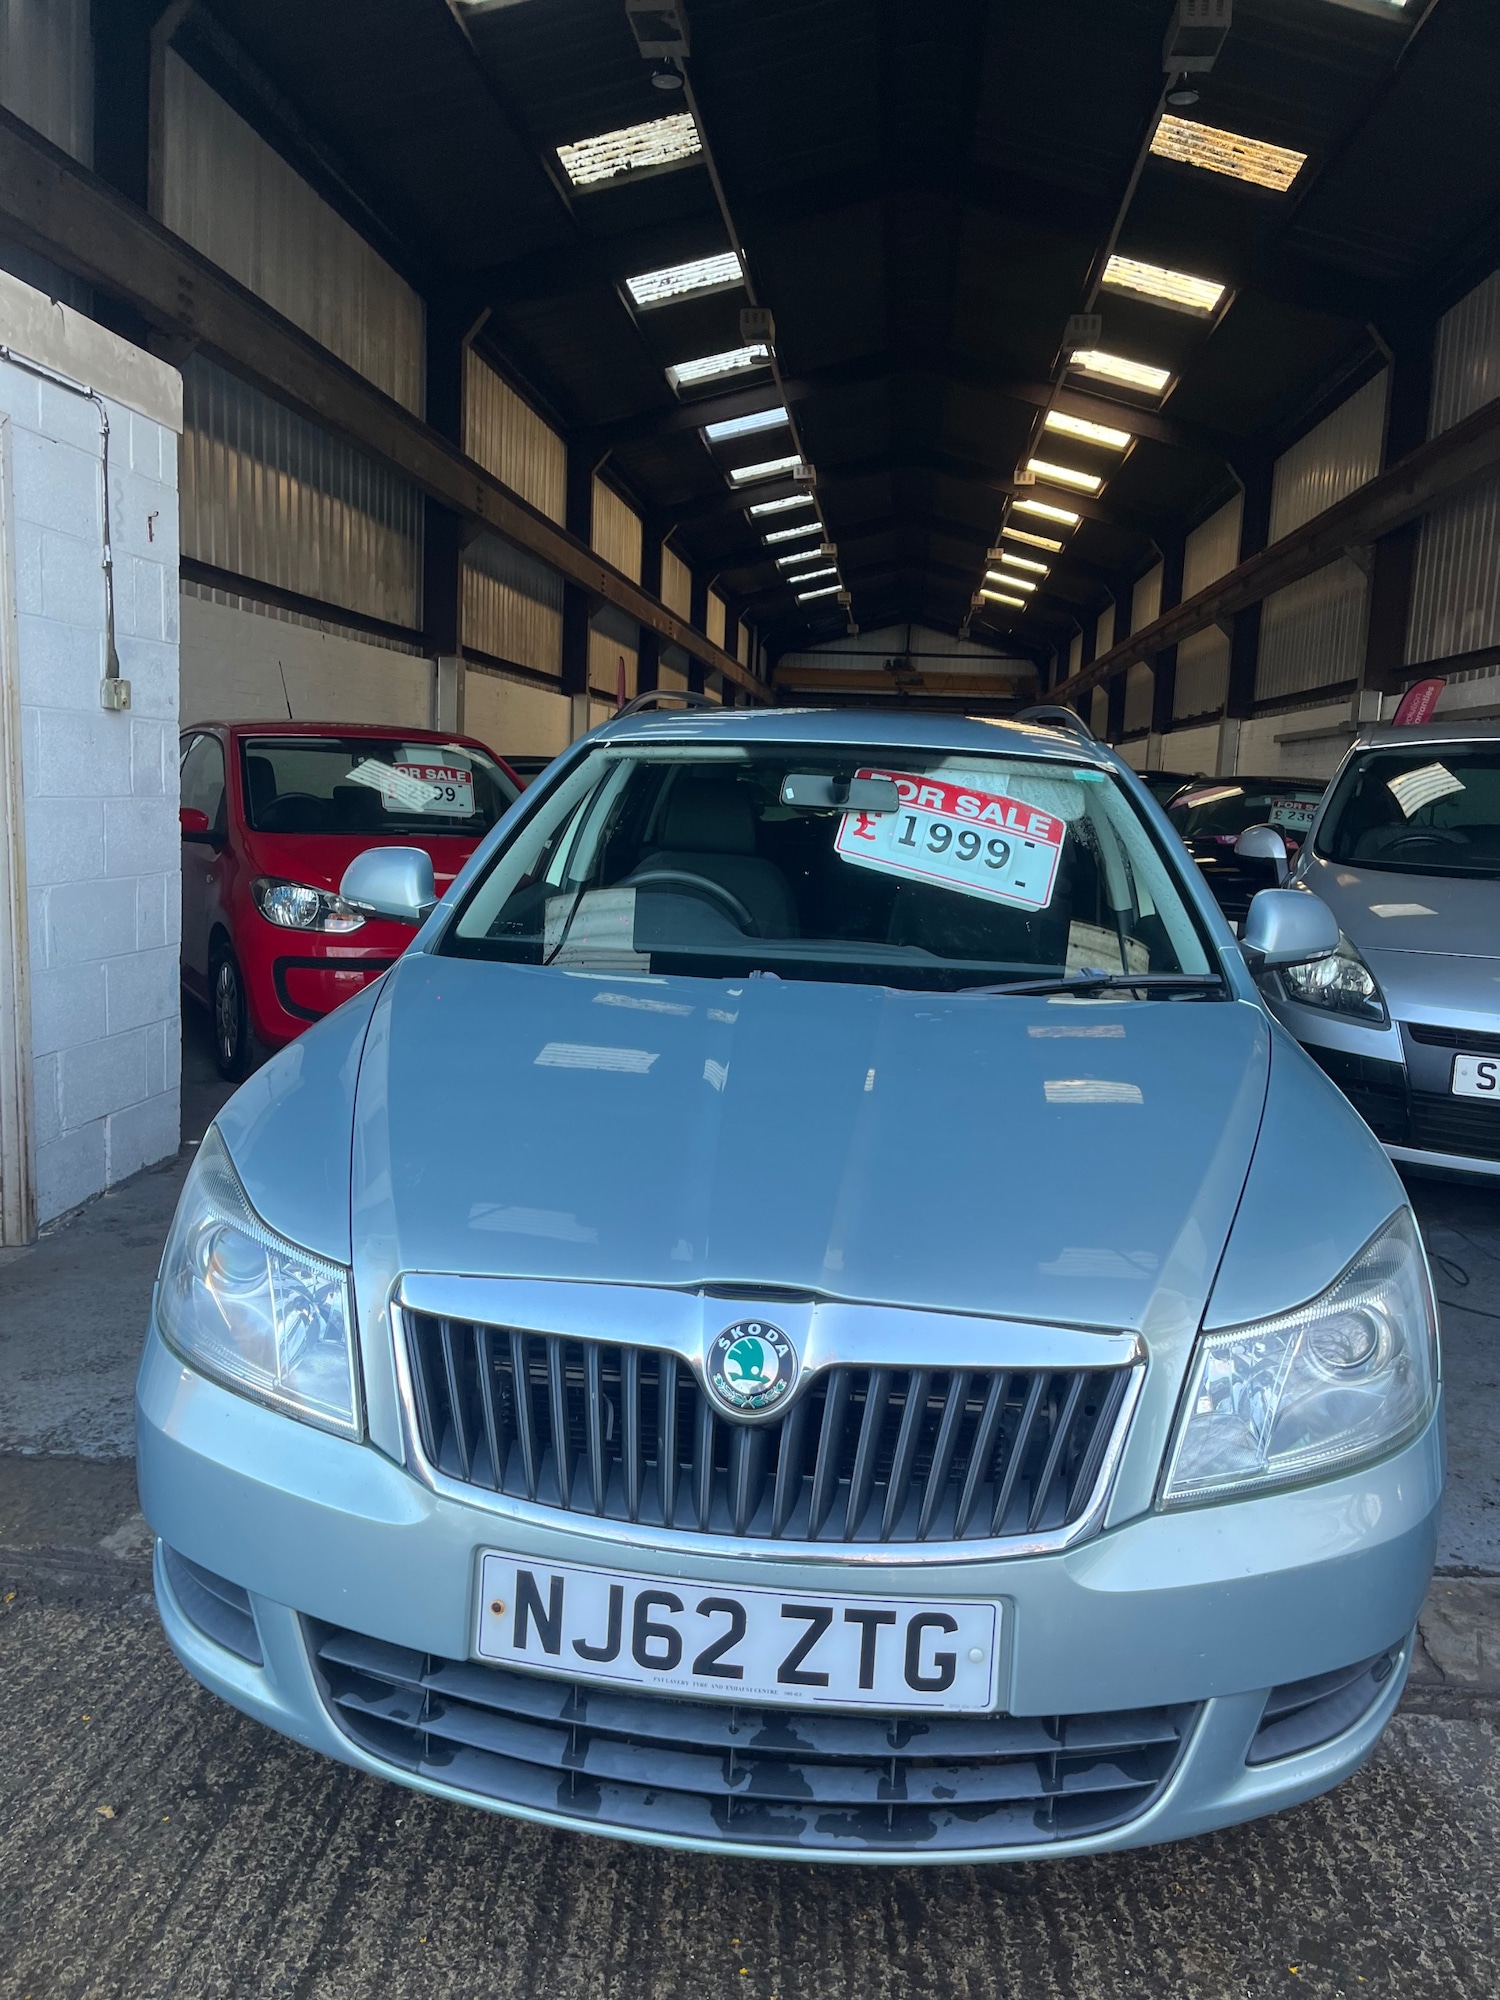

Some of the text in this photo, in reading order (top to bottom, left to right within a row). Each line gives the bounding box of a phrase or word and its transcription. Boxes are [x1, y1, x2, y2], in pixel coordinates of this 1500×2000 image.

[425, 768, 467, 782] SALE
[870, 773, 1052, 839] OR SALE
[1277, 801, 1303, 810] FOR
[1274, 810, 1283, 821] £
[898, 815, 1011, 869] 1999
[513, 1569, 959, 1693] NJ62 ZTG
[725, 1685, 752, 1693] EXHAUST
[753, 1687, 779, 1695] CENTRE
